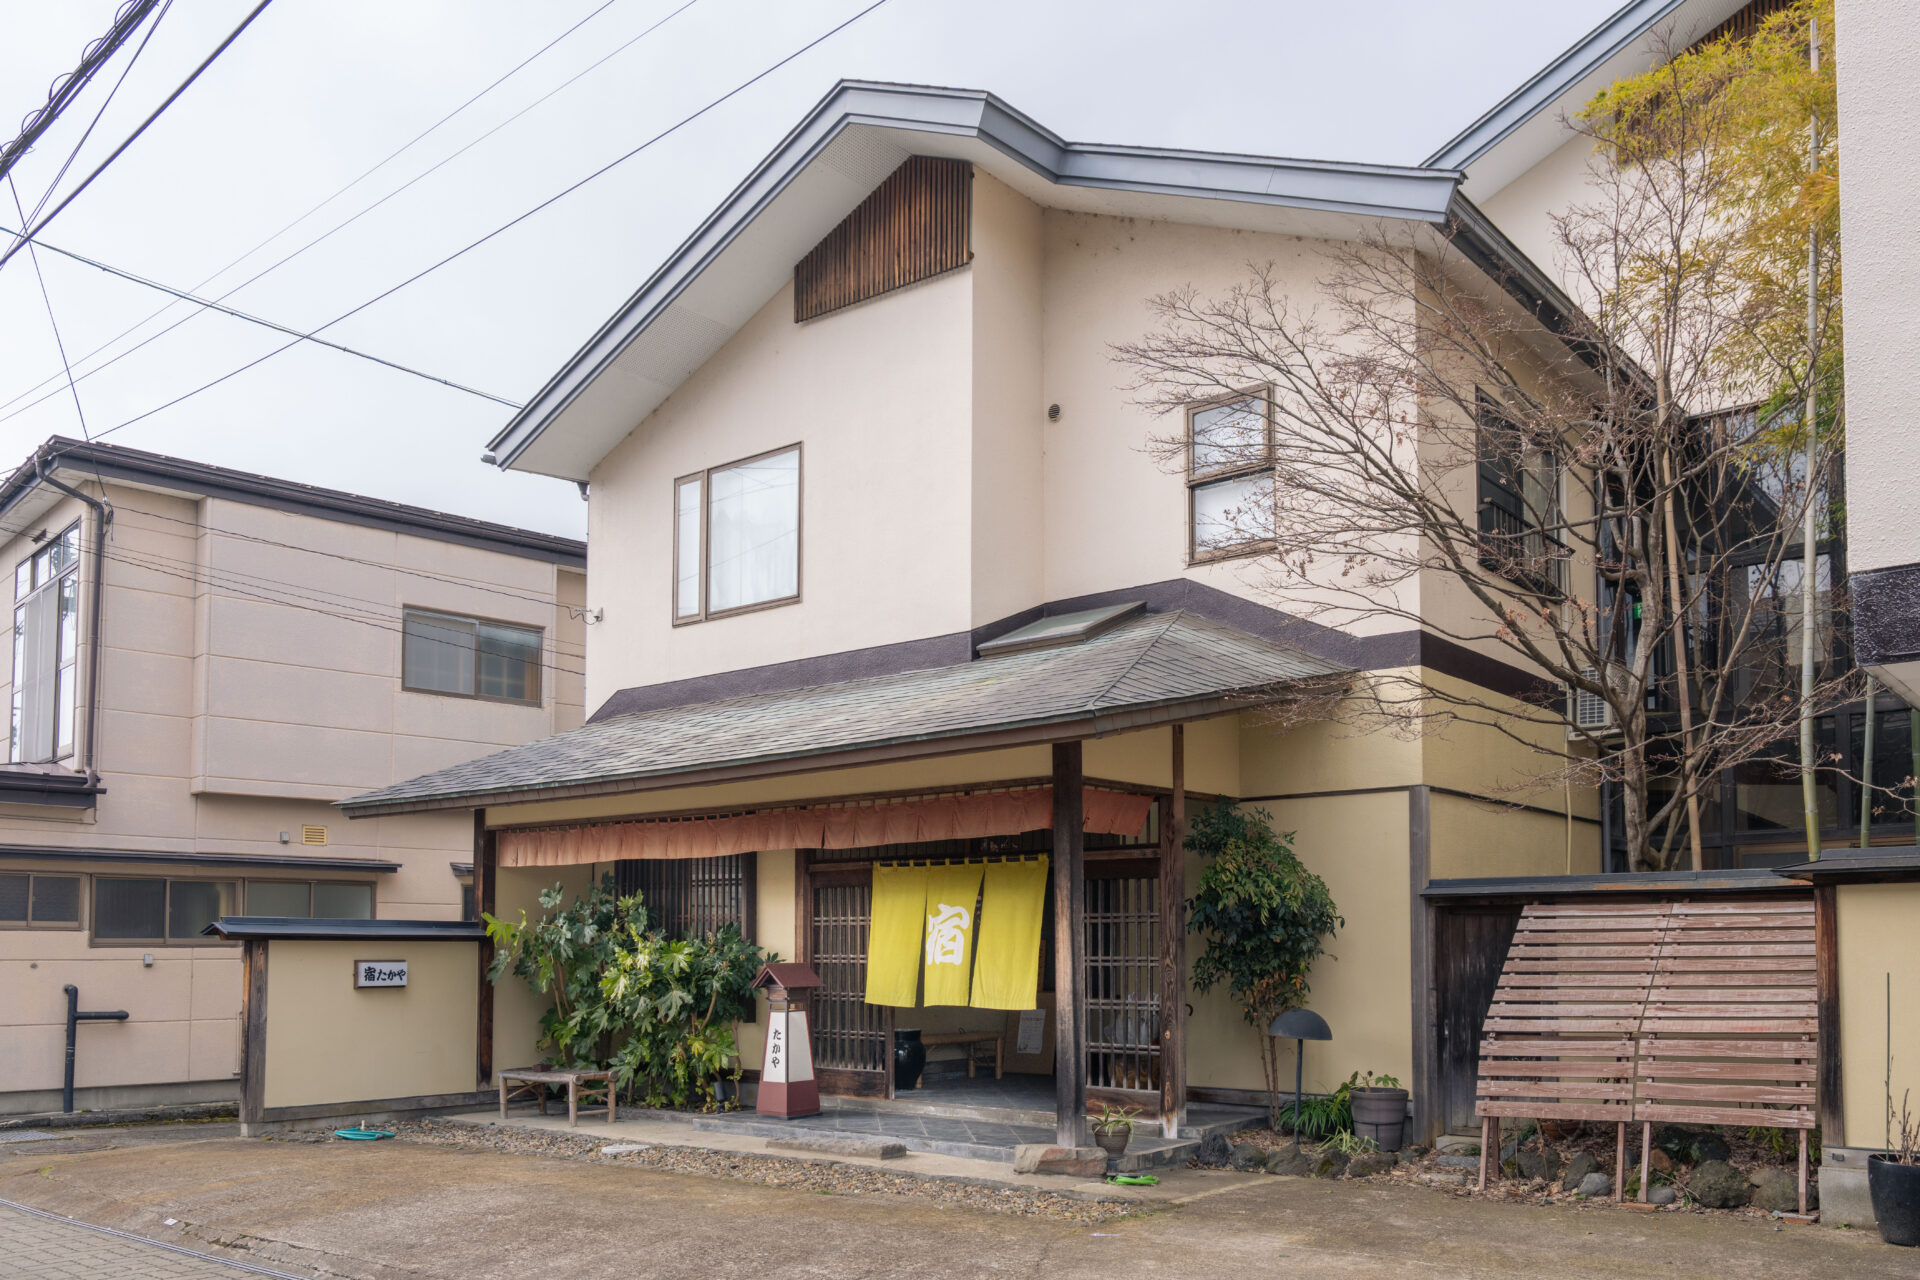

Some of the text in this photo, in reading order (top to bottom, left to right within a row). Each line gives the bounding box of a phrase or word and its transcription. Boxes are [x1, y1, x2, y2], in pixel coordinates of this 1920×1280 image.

[926, 903, 970, 965] 宿
[364, 966, 407, 981] 宿たかや
[771, 1028, 782, 1068] たかや
